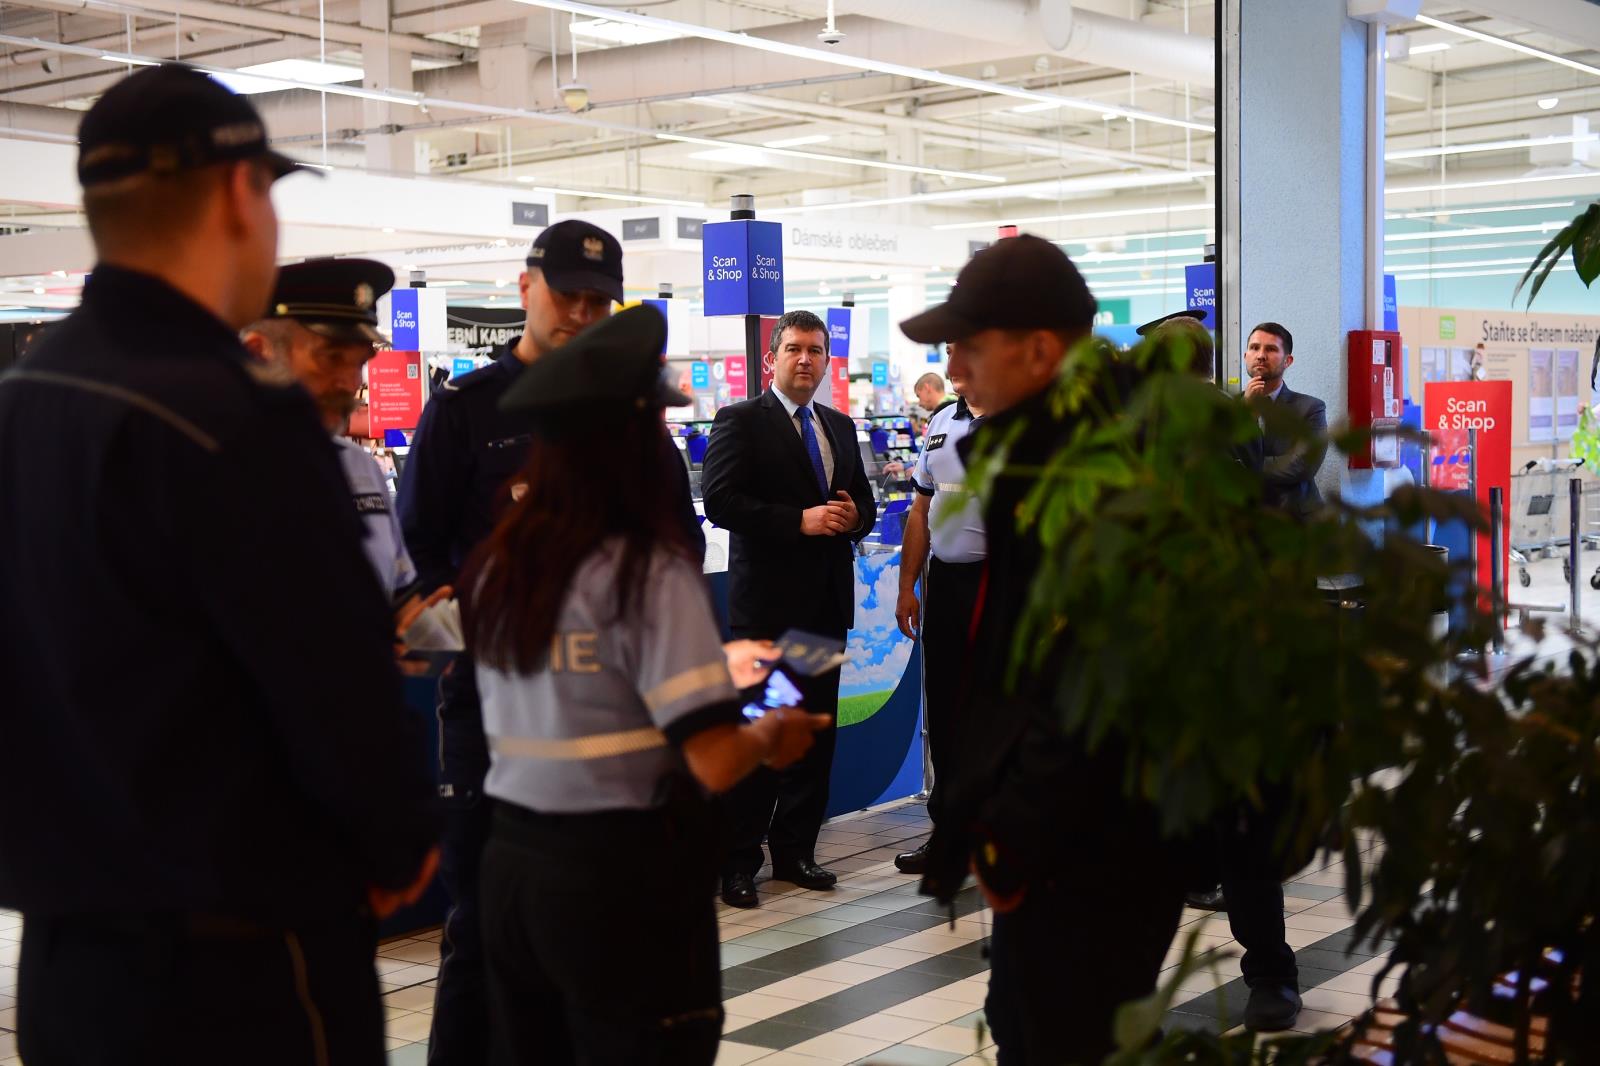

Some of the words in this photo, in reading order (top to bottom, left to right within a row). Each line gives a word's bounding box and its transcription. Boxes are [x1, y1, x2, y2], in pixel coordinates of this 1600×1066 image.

[712, 255, 737, 268] Scan
[756, 254, 776, 267] Scan
[707, 269, 715, 281] &
[716, 268, 743, 282] Shop
[751, 267, 759, 279] &
[759, 267, 780, 283] Shop
[1193, 288, 1214, 298] Scan
[1189, 297, 1196, 307] &
[396, 310, 413, 320] Scan
[393, 319, 399, 328] &
[398, 319, 416, 330] Shop
[830, 323, 847, 333] Scan
[1482, 319, 1516, 342] Staňte
[1517, 328, 1529, 342] se
[447, 324, 478, 345] EBNÍ
[1446, 397, 1486, 413] Scan
[1438, 414, 1449, 430] &
[1451, 413, 1496, 433] Shop
